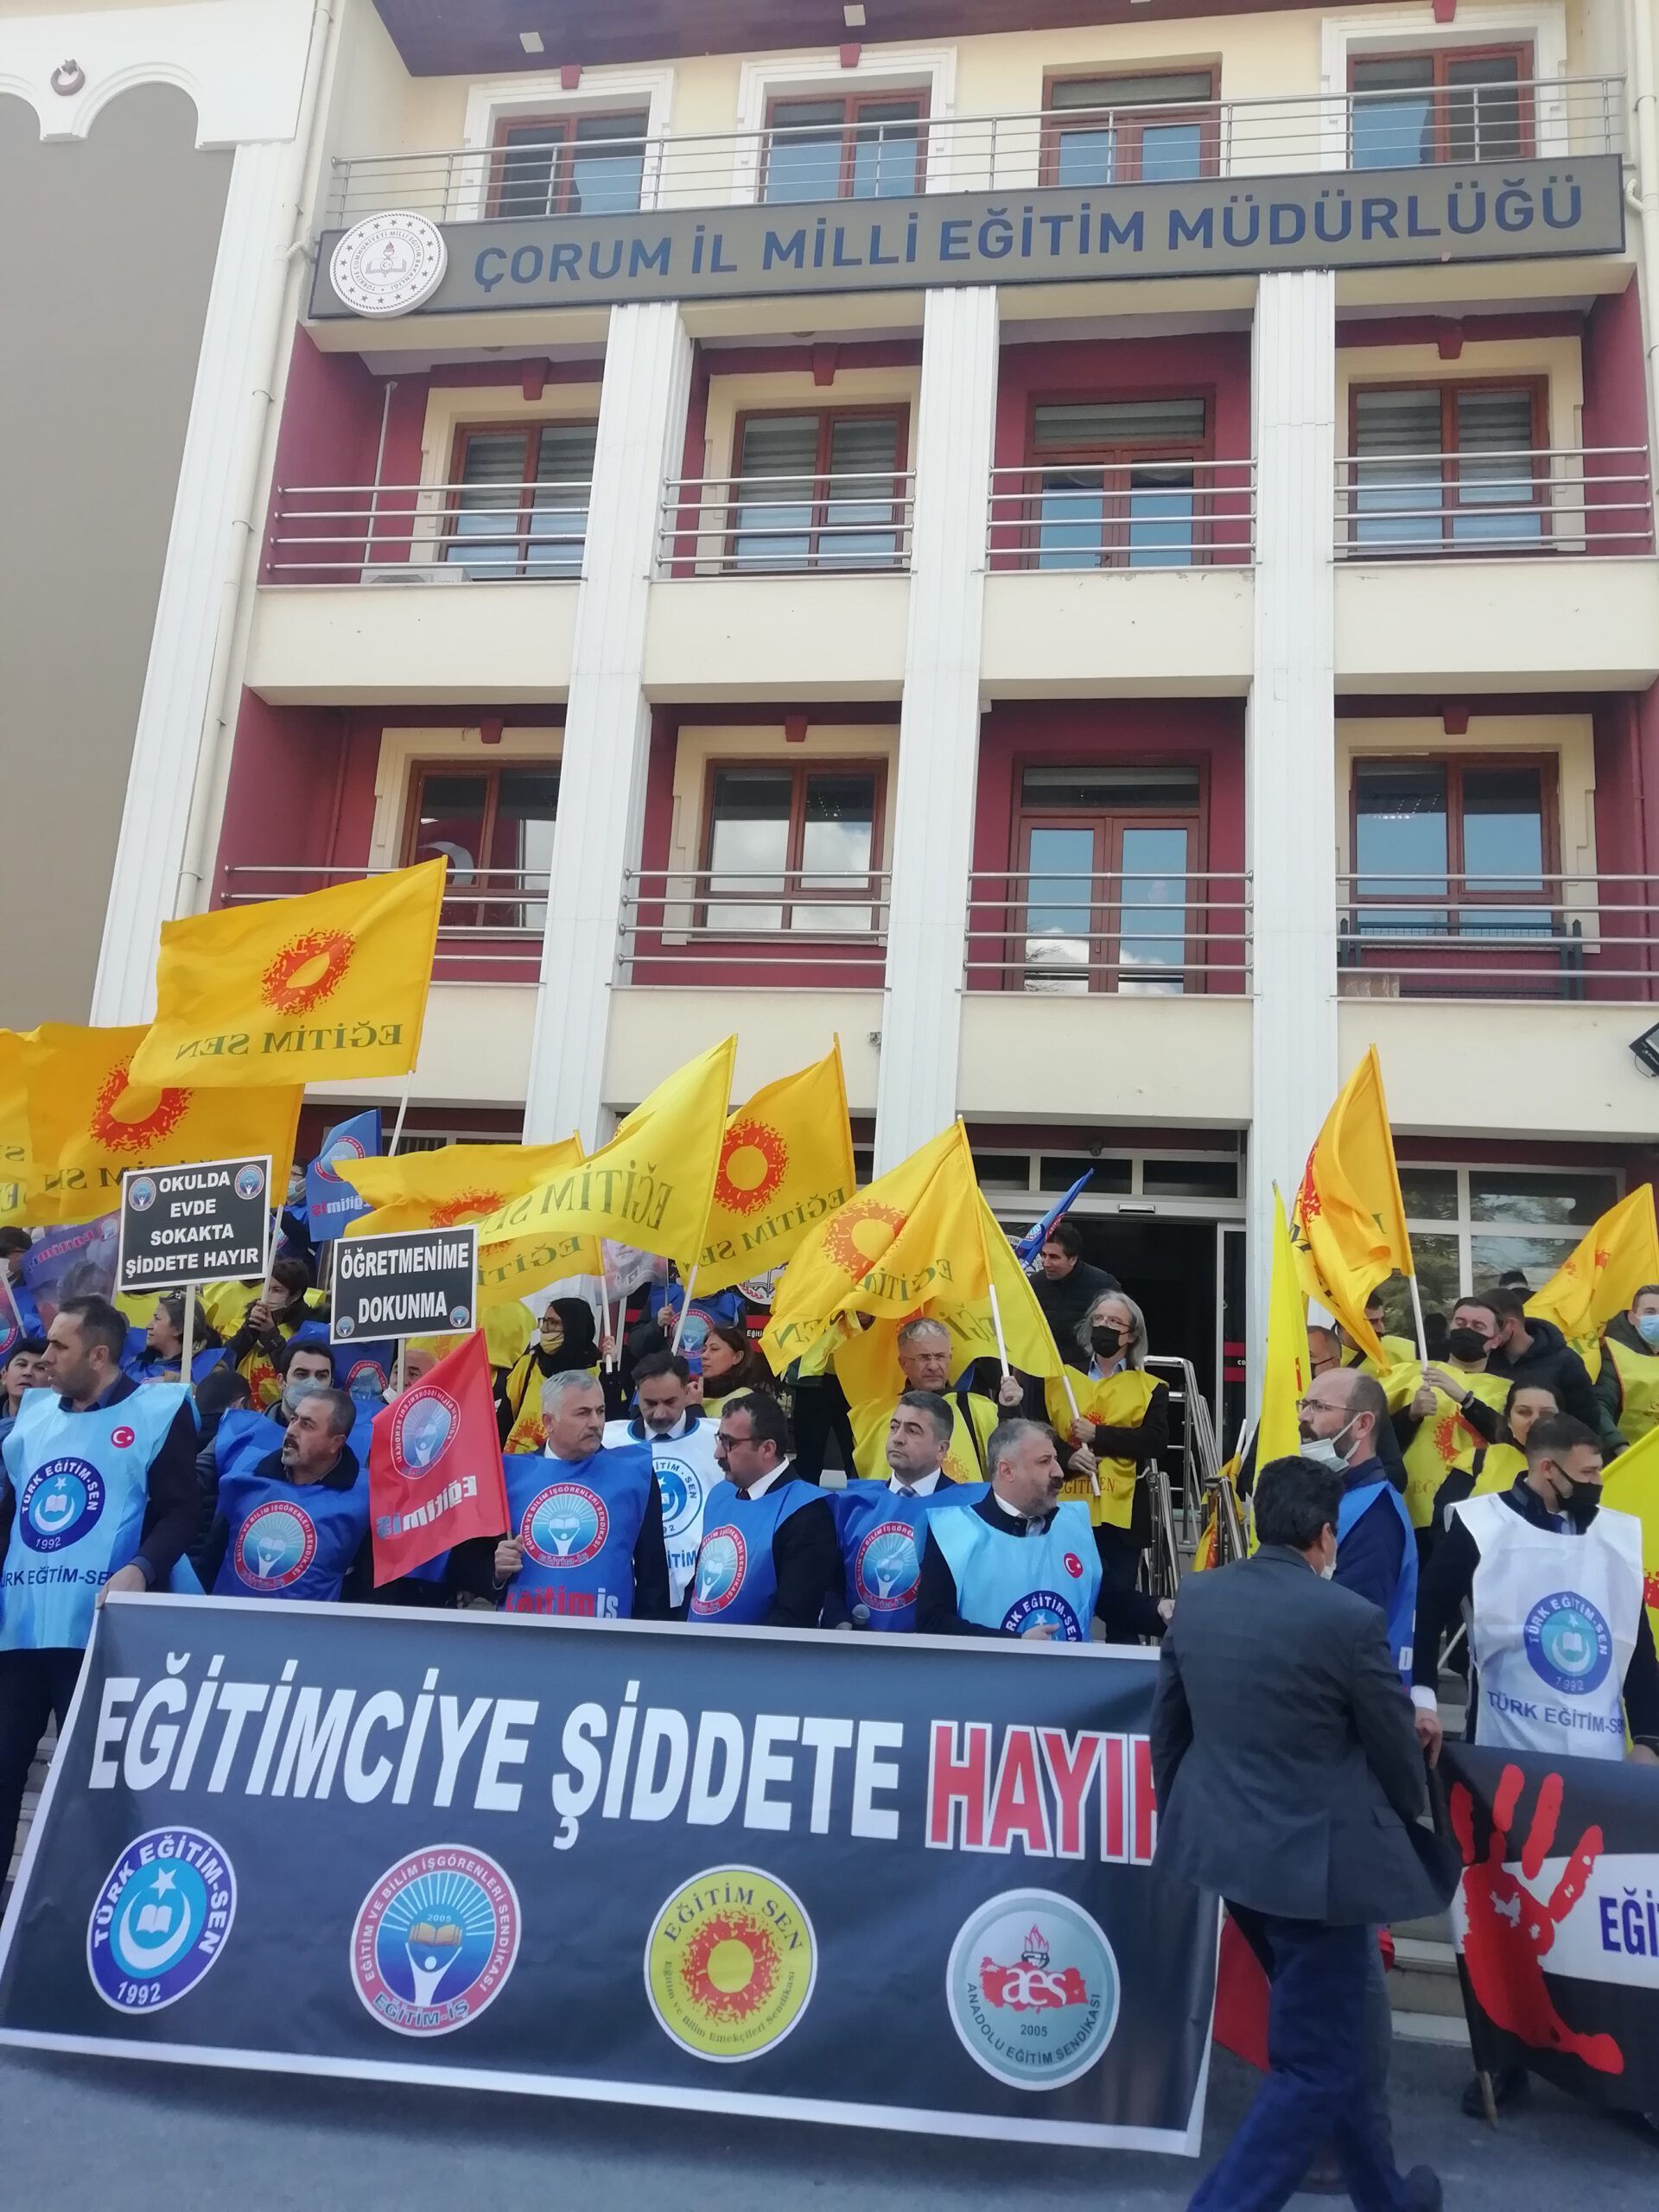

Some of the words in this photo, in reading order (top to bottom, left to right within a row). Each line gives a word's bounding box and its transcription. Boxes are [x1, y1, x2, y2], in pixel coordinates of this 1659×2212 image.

[474, 237, 671, 293] ÇORUM
[691, 224, 738, 275] İL
[761, 212, 918, 270] MİLLİ
[938, 201, 1144, 262] EĞİTİM
[1167, 175, 1583, 251] MÜDÜRLÜĞÜ
[159, 1171, 231, 1192] OKULDA
[170, 1198, 217, 1218] EVDE
[150, 1224, 234, 1246] SOKAKTA
[125, 1255, 199, 1279] ŞİDDETE
[203, 1247, 259, 1268] HAYIR
[340, 1238, 469, 1280] ÖĞRETMENİME
[358, 1291, 448, 1324] DOKUNMA
[1099, 1477, 1116, 1492] EN
[35, 1536, 61, 1549] 1992
[0, 1570, 25, 1588] ÜRK
[29, 1565, 113, 1586] EĞİTİM-SE
[1487, 1690, 1538, 1720] TÜRK
[88, 1651, 539, 1812] EĞİTİMCİYE
[552, 1680, 904, 1850] ŞİDDETE
[94, 1860, 135, 1949] TÜRK
[139, 1834, 229, 1955] EĞİTİM-SEN
[359, 1924, 375, 1982] EĞİTİM
[369, 1900, 384, 1919] VE
[382, 1864, 419, 1899] BİLİM
[422, 1853, 505, 1903] İŞGÖRENLERİ
[480, 1904, 511, 1992] SENDİKASI
[663, 1881, 755, 1943] EĞİTİM
[760, 1898, 804, 1951] SEN
[1599, 1885, 1659, 1957] EĞİ
[118, 1980, 162, 2005] 1992
[682, 2015, 707, 2038] Bilim
[709, 2022, 766, 2044] Emekçileri
[766, 1971, 796, 2025] Sendikası
[967, 1982, 1006, 2051] ANADOLU
[1006, 2045, 1053, 2065] EĞİTİM
[1056, 1993, 1101, 2062] SENDİKASI
[1020, 2023, 1048, 2037] 2005
